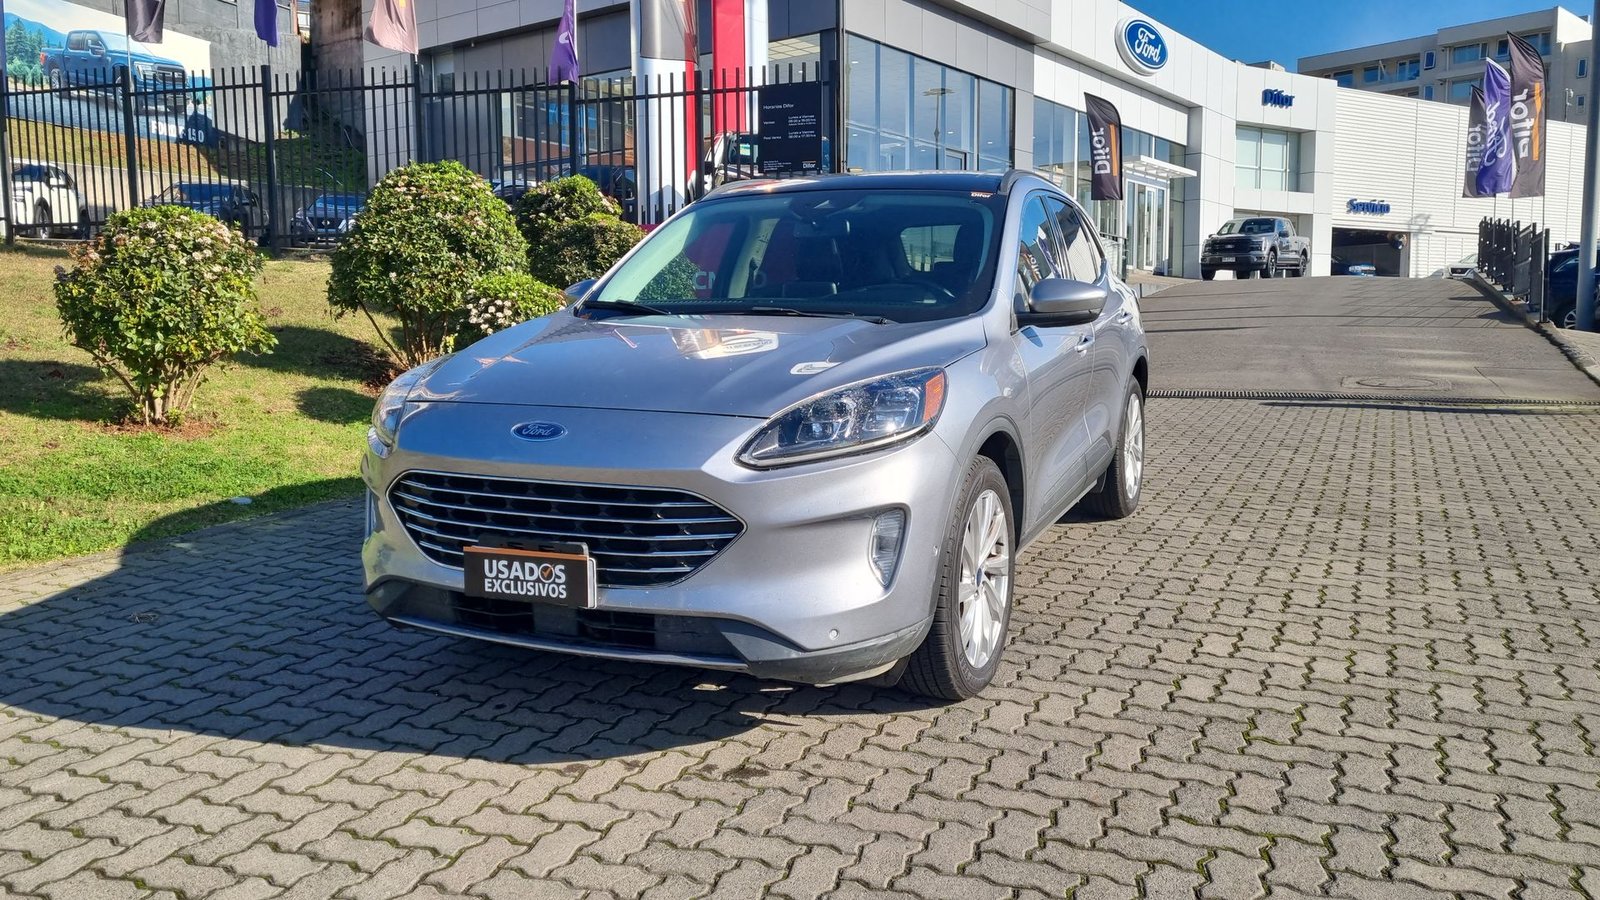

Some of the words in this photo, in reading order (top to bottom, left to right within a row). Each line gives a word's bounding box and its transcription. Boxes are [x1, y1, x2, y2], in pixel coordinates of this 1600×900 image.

[1135, 27, 1161, 62] Ford
[1262, 89, 1295, 108] Difor
[1346, 198, 1390, 216] Servicio
[522, 423, 554, 436] Ford
[484, 559, 566, 584] USADOS
[484, 578, 567, 598] EXCLUSIVOS
